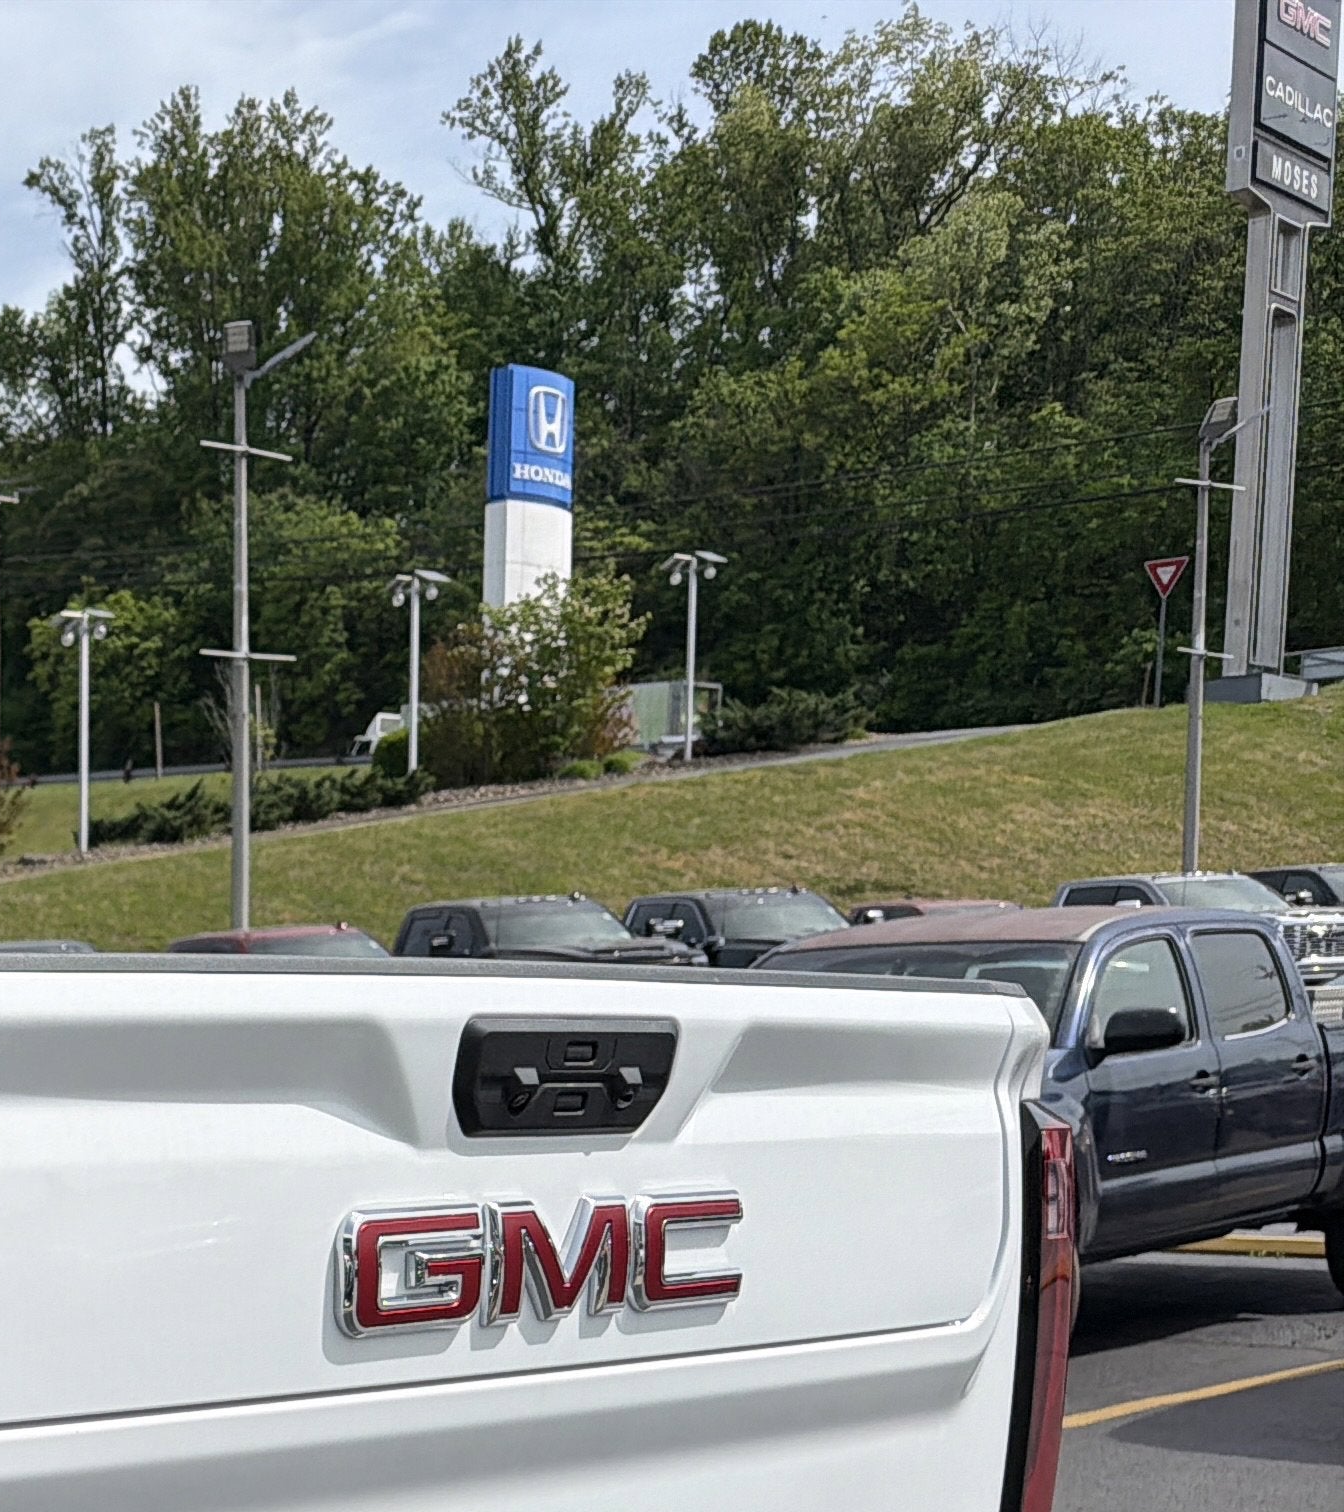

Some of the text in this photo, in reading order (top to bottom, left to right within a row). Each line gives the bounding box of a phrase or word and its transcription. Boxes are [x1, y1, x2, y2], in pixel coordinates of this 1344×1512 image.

[1279, 0, 1332, 48] GMC
[1265, 75, 1333, 128] CADILLAC
[1271, 154, 1318, 199] MOSES
[512, 462, 573, 491] HONDA
[334, 1189, 744, 1340] GMC
